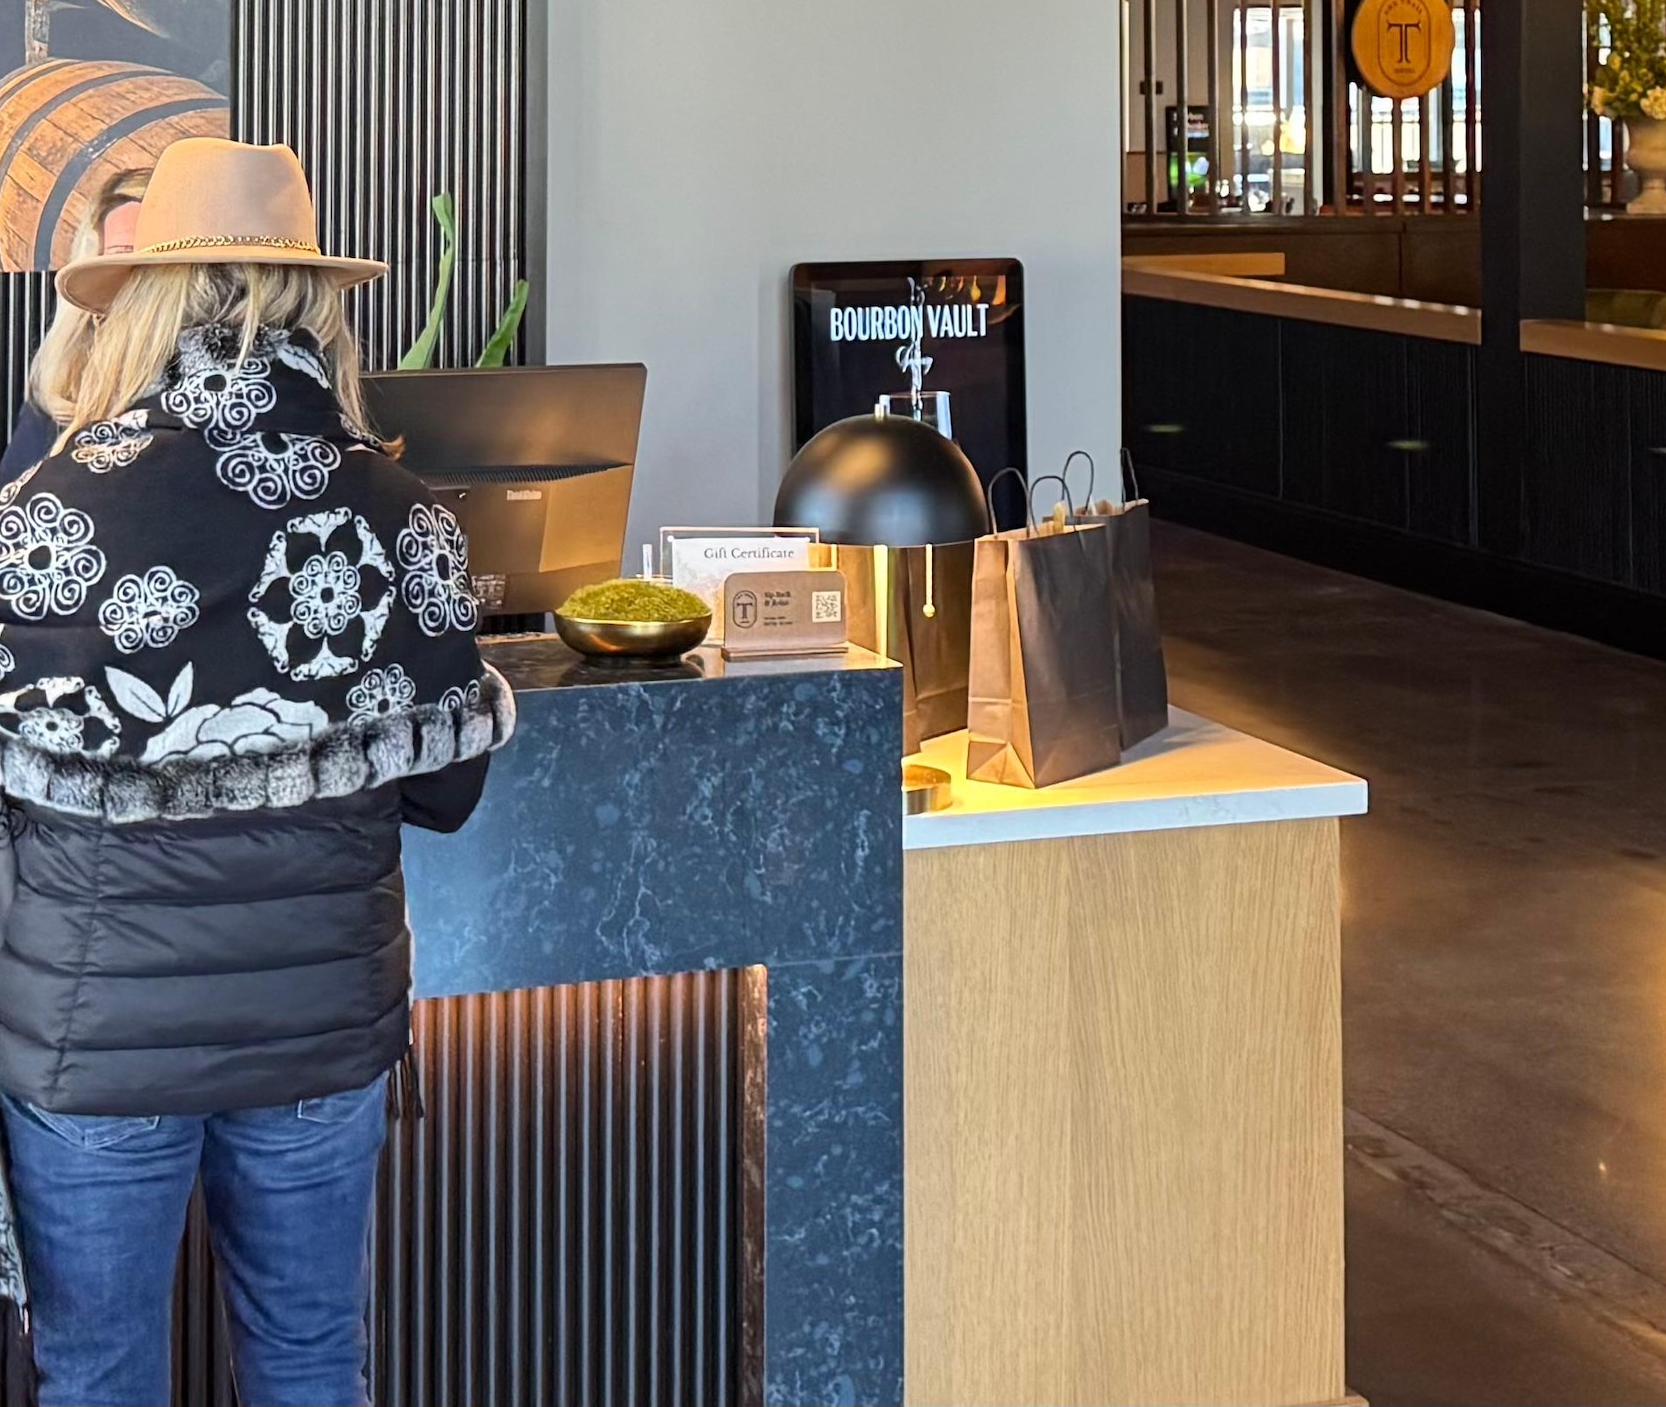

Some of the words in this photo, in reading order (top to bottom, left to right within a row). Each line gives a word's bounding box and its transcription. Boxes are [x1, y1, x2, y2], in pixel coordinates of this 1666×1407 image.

[1387, 19, 1421, 64] T
[830, 304, 923, 341] BOURBON
[927, 303, 989, 338] VAULT
[704, 547, 727, 559] Gift
[731, 547, 795, 559] Certificate
